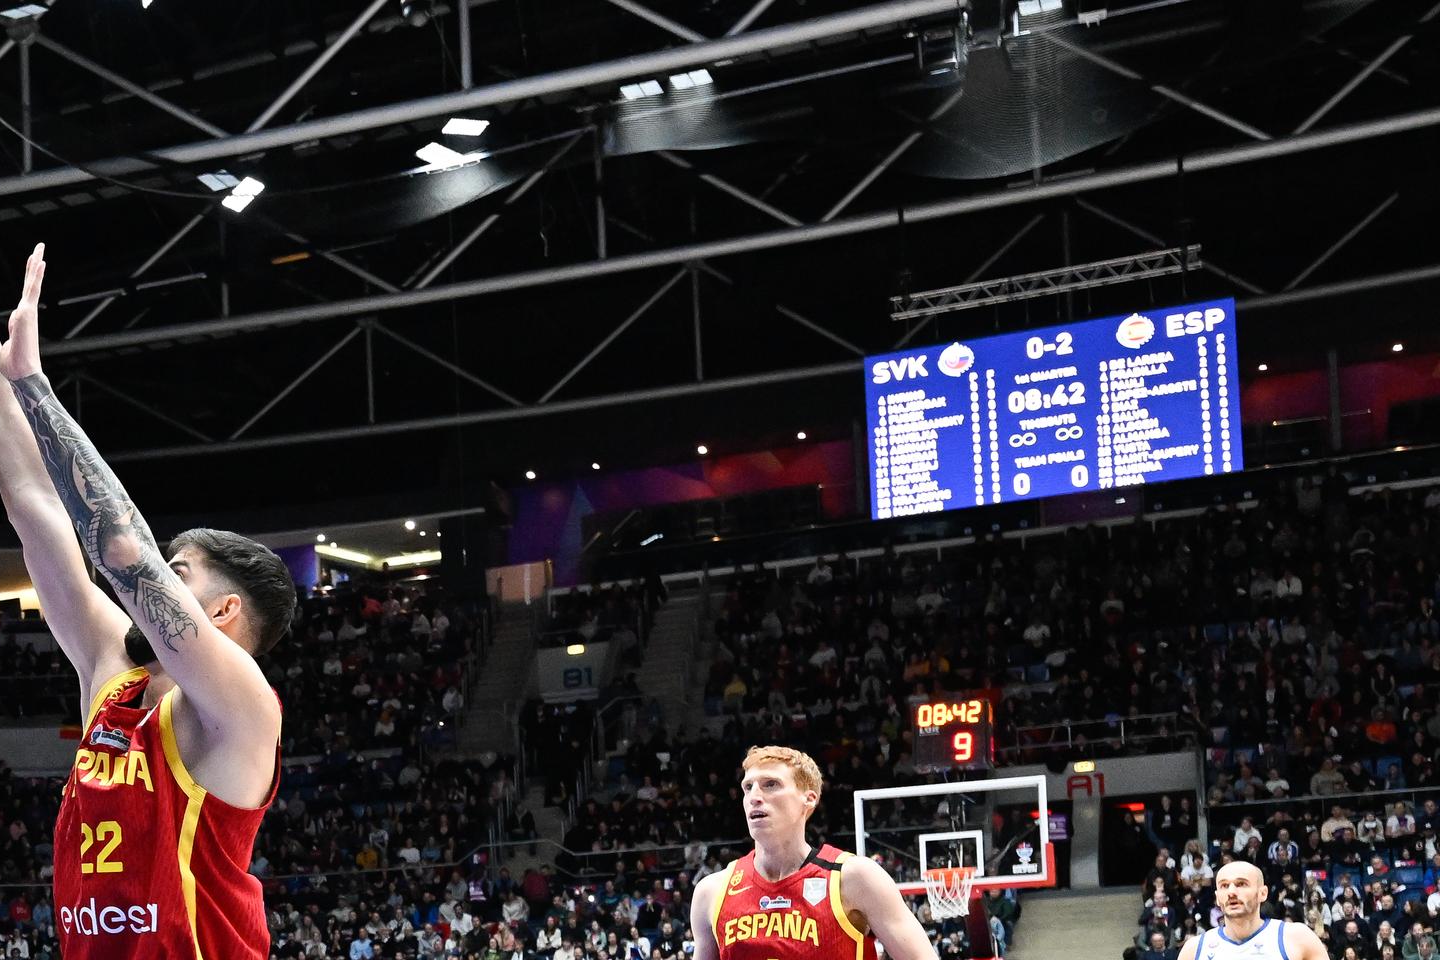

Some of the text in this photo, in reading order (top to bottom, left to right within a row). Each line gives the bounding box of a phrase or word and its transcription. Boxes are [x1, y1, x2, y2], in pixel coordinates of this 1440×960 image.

[1166, 308, 1225, 338] ESP
[1026, 332, 1073, 359] 0-2
[872, 355, 928, 384] SVK
[1008, 381, 1086, 414] 08:42
[1013, 473, 1031, 496] 0
[1071, 465, 1089, 488] 0
[917, 700, 982, 728] 08:42
[953, 732, 972, 761] 9
[1066, 773, 1106, 800] A1
[80, 820, 124, 874] 22
[724, 910, 820, 947] ESPAÑA
